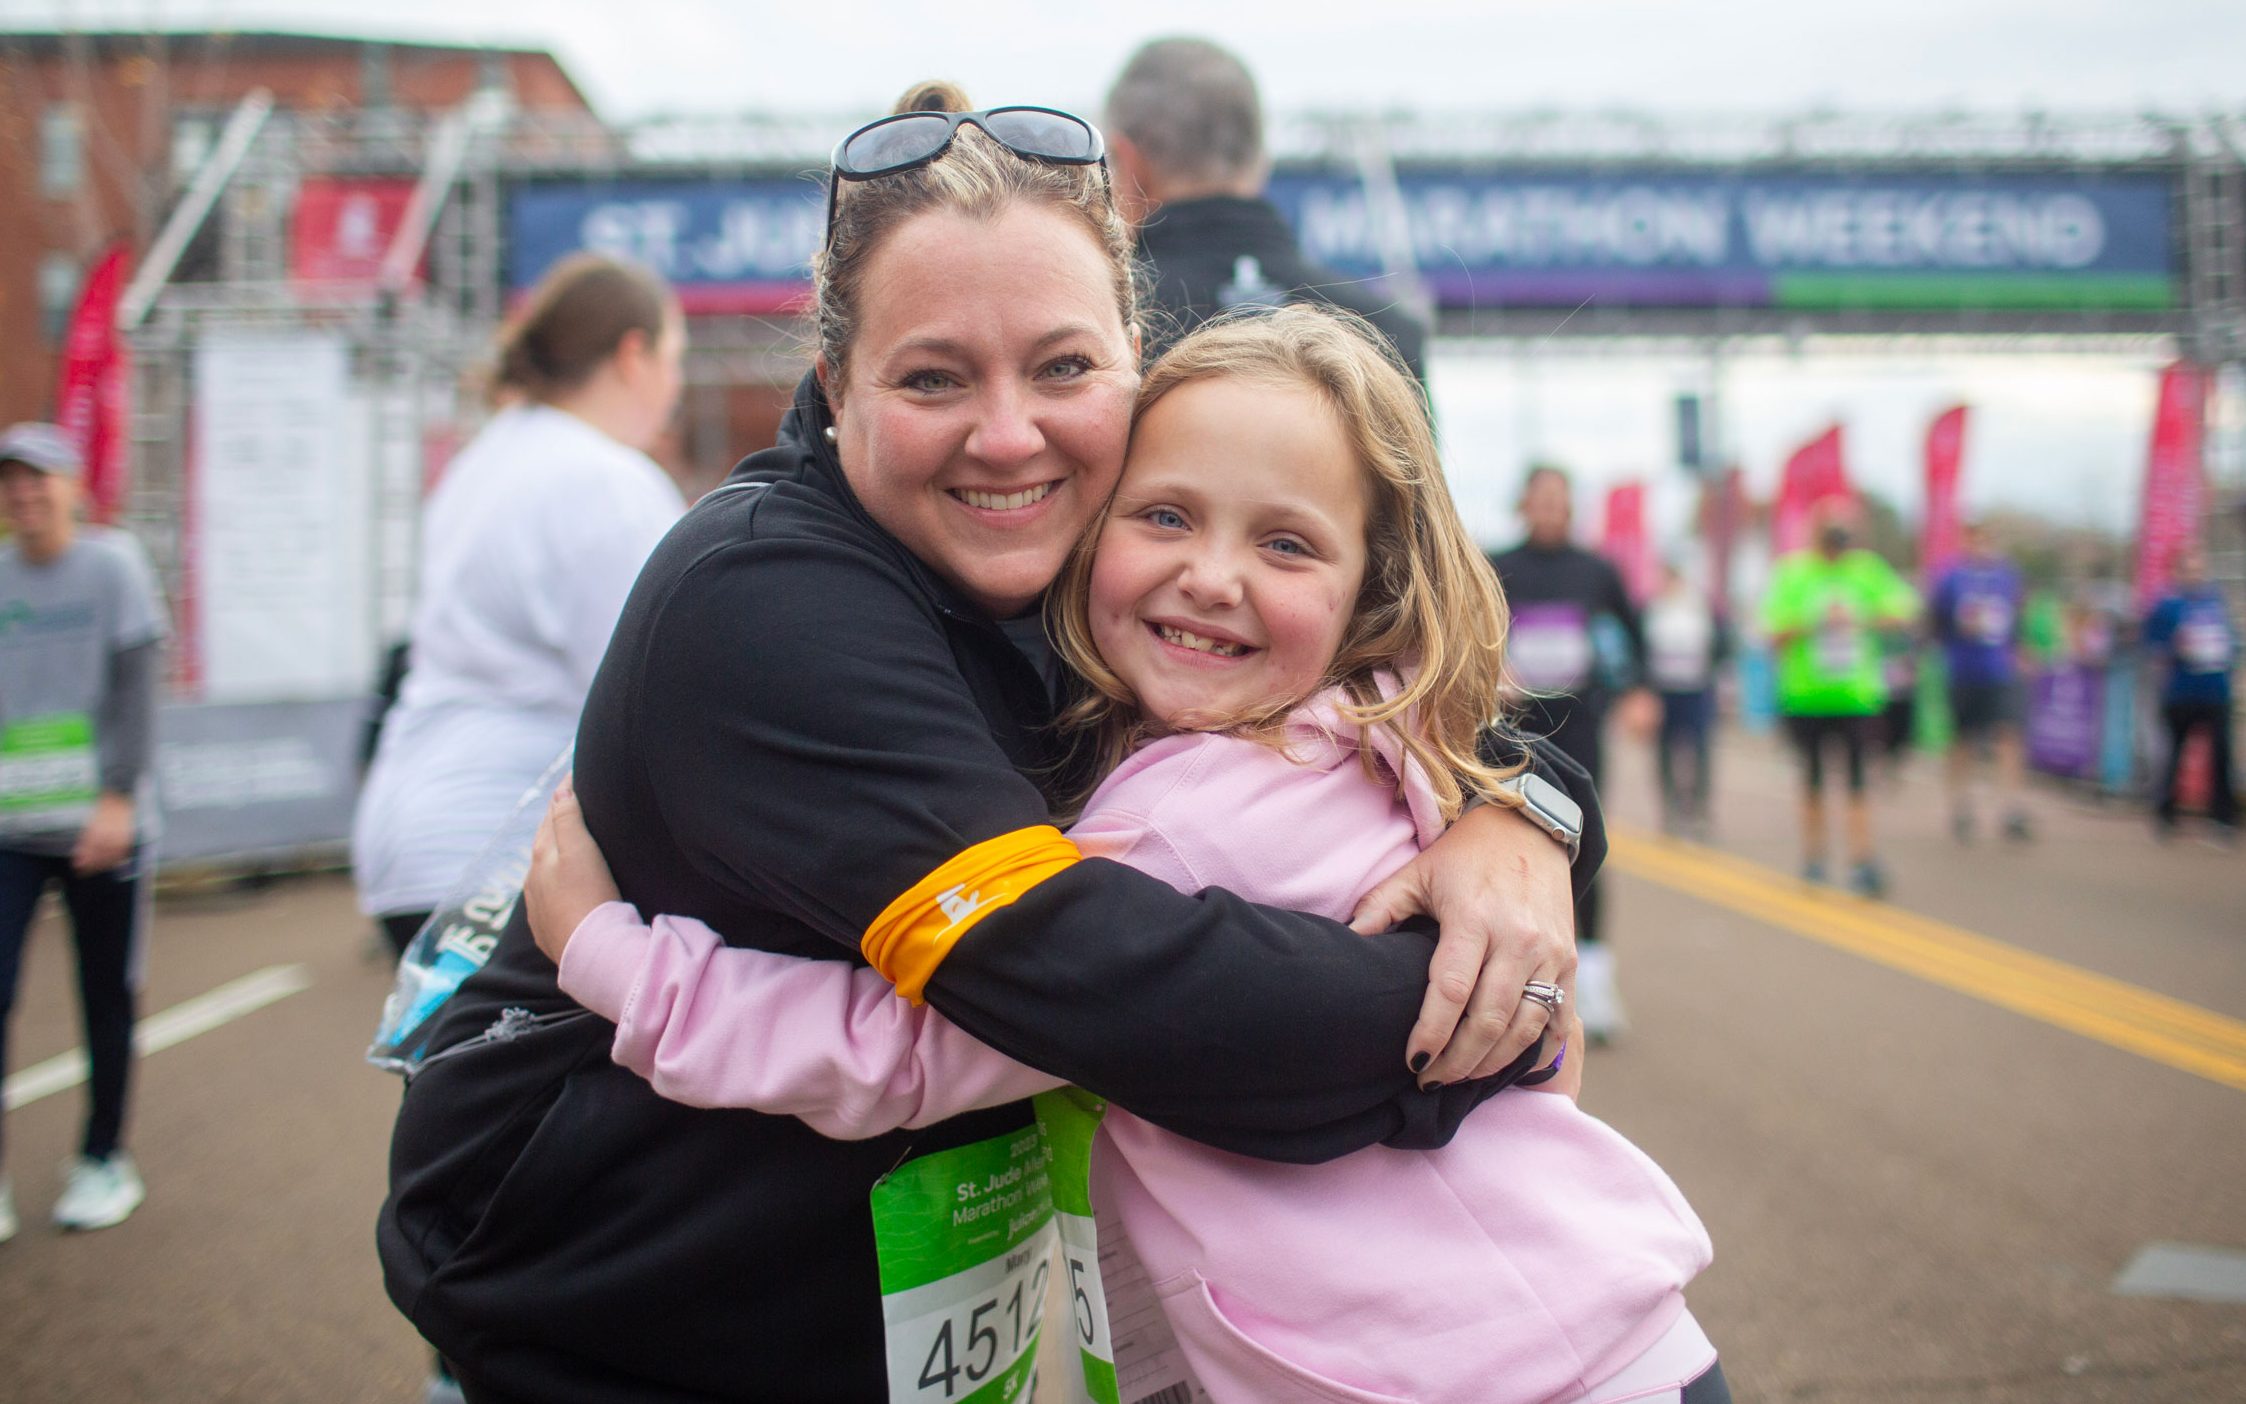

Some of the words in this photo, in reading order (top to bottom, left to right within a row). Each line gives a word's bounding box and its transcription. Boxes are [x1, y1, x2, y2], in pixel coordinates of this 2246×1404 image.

[694, 198, 828, 278] JU
[1303, 188, 1729, 263] MRATHON
[1745, 190, 2105, 267] WEEKEND
[957, 1182, 981, 1201] St.
[984, 1167, 1021, 1193] Jude
[953, 1190, 1023, 1227] Marathon
